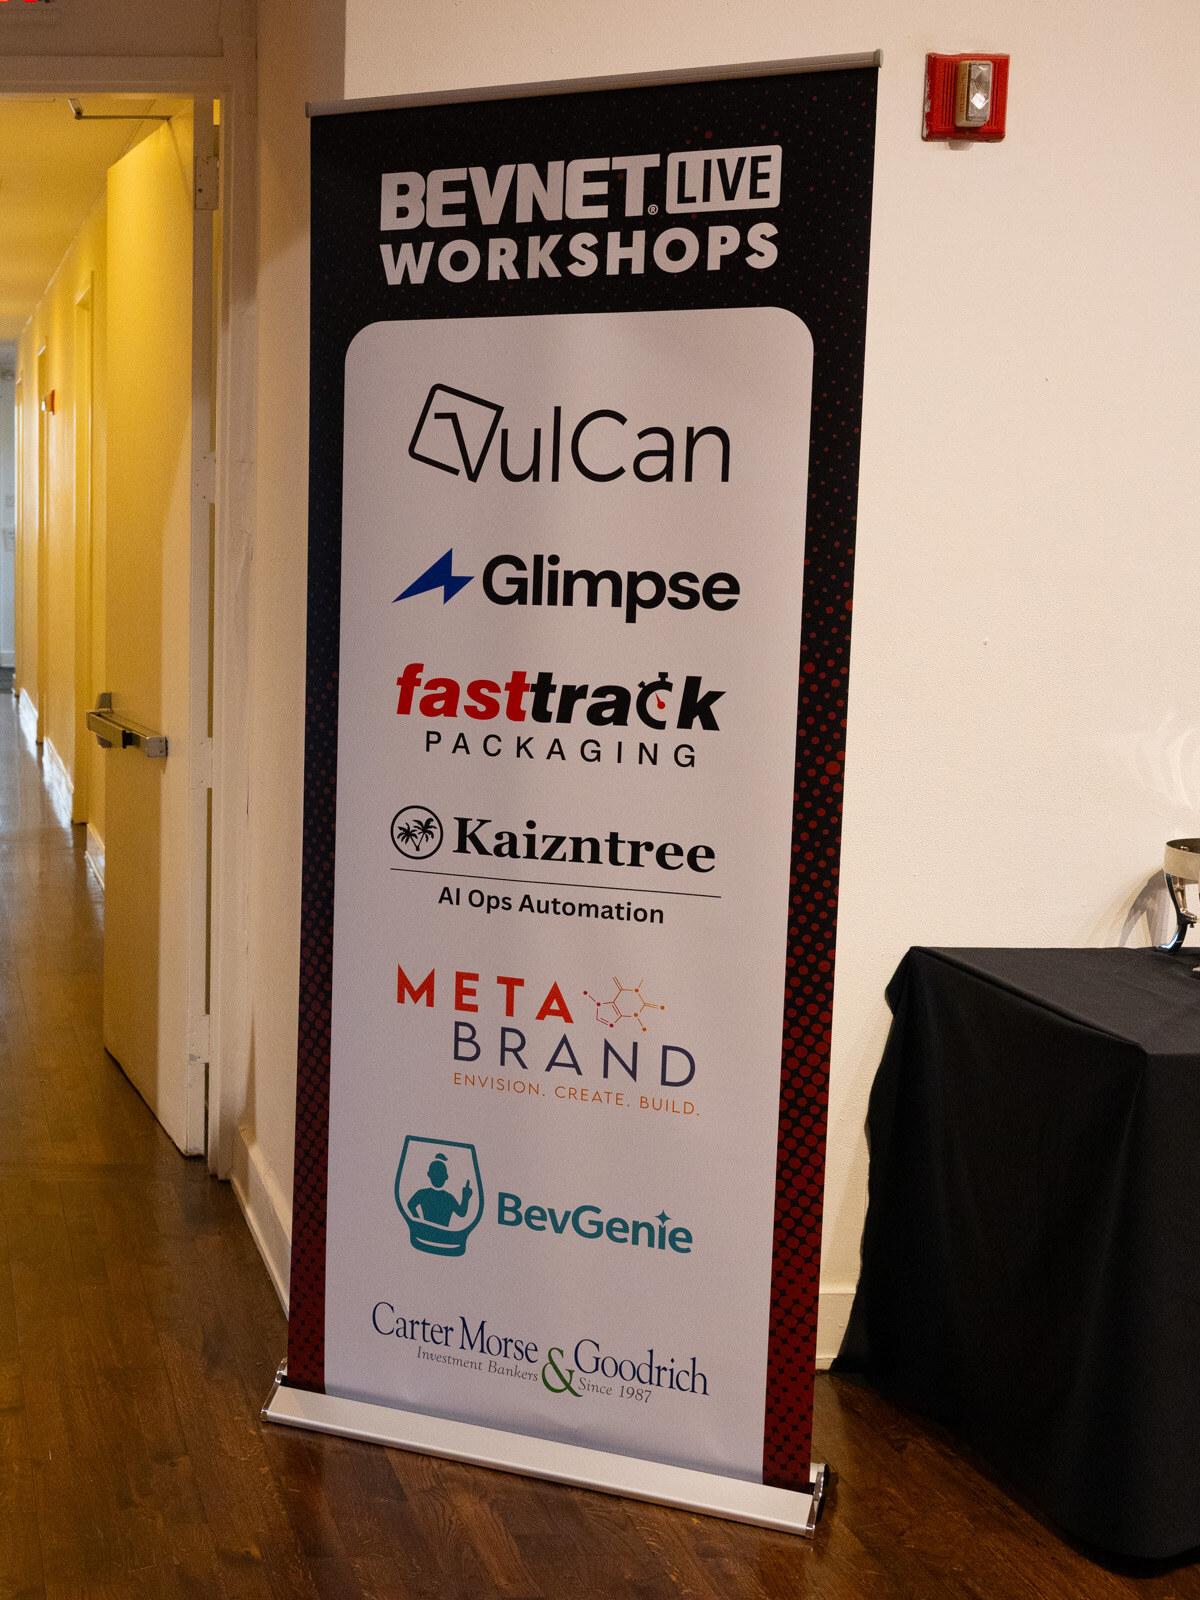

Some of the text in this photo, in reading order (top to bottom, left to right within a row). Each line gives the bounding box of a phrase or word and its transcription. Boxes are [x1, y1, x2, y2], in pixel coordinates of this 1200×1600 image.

[675, 154, 773, 205] LIVE
[380, 223, 779, 285] WORKSHOPS
[408, 383, 730, 484] VulCan
[481, 554, 741, 624] Glimpse
[425, 731, 698, 768] PACKAGING
[453, 816, 717, 873] Kaizntree
[438, 887, 665, 924] AI Ops Automation
[397, 964, 574, 1025] META
[453, 1021, 696, 1087] BRAND
[453, 1073, 700, 1117] ENVISION. CREATE. BUILD.
[497, 1192, 694, 1255] BevGenie
[372, 1301, 710, 1398] Carter Morse & Goodrich
[416, 1346, 539, 1382] Investment Bankers
[578, 1377, 652, 1404] Since 1987
